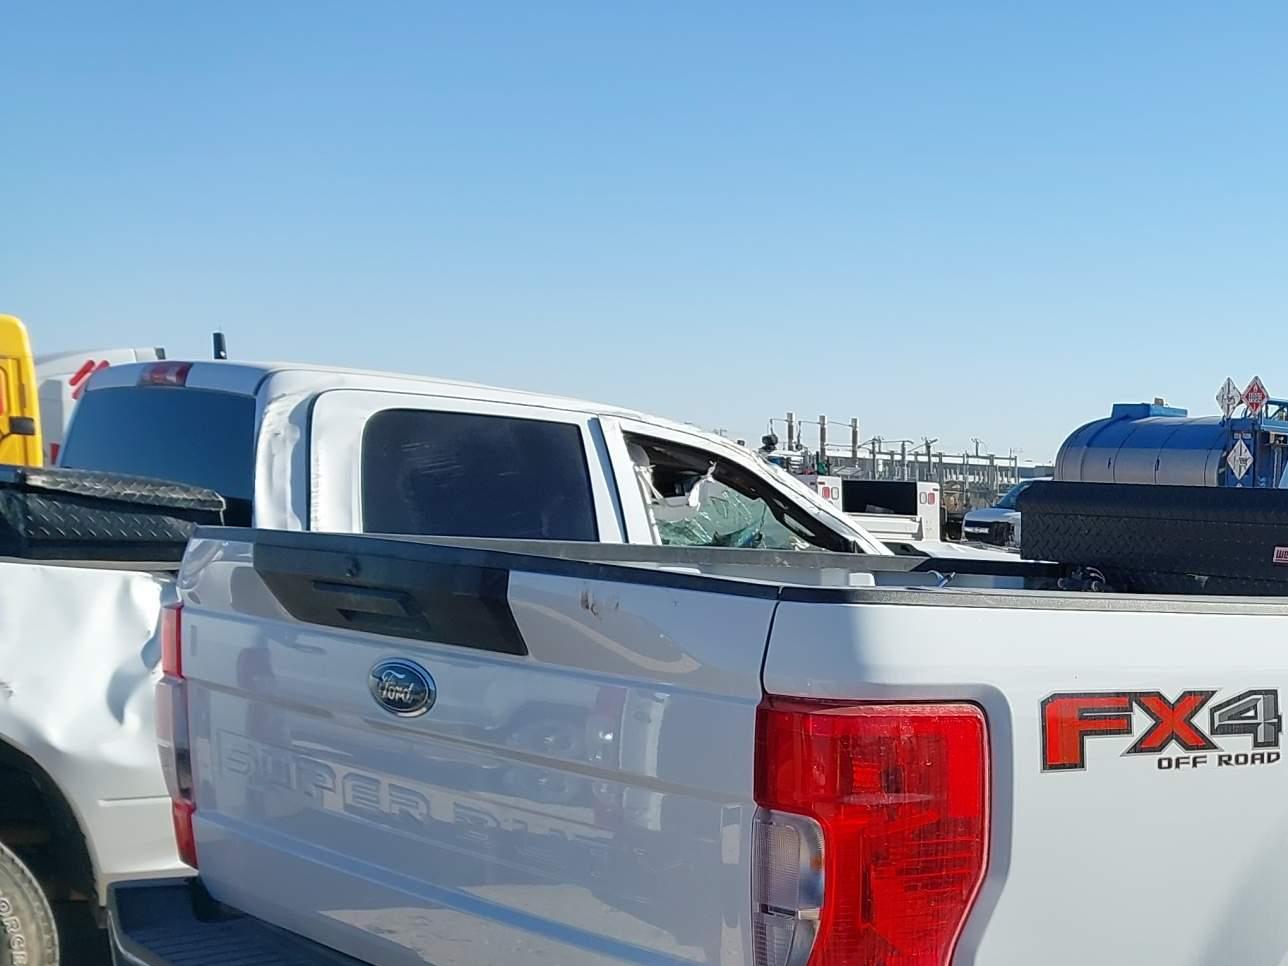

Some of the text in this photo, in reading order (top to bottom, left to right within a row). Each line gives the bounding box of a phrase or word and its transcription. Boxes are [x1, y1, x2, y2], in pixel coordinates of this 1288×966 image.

[382, 669, 415, 704] Ford
[1040, 688, 1283, 773] FX4
[218, 742, 434, 825] SUPER
[1157, 751, 1281, 771] OFF ROAD
